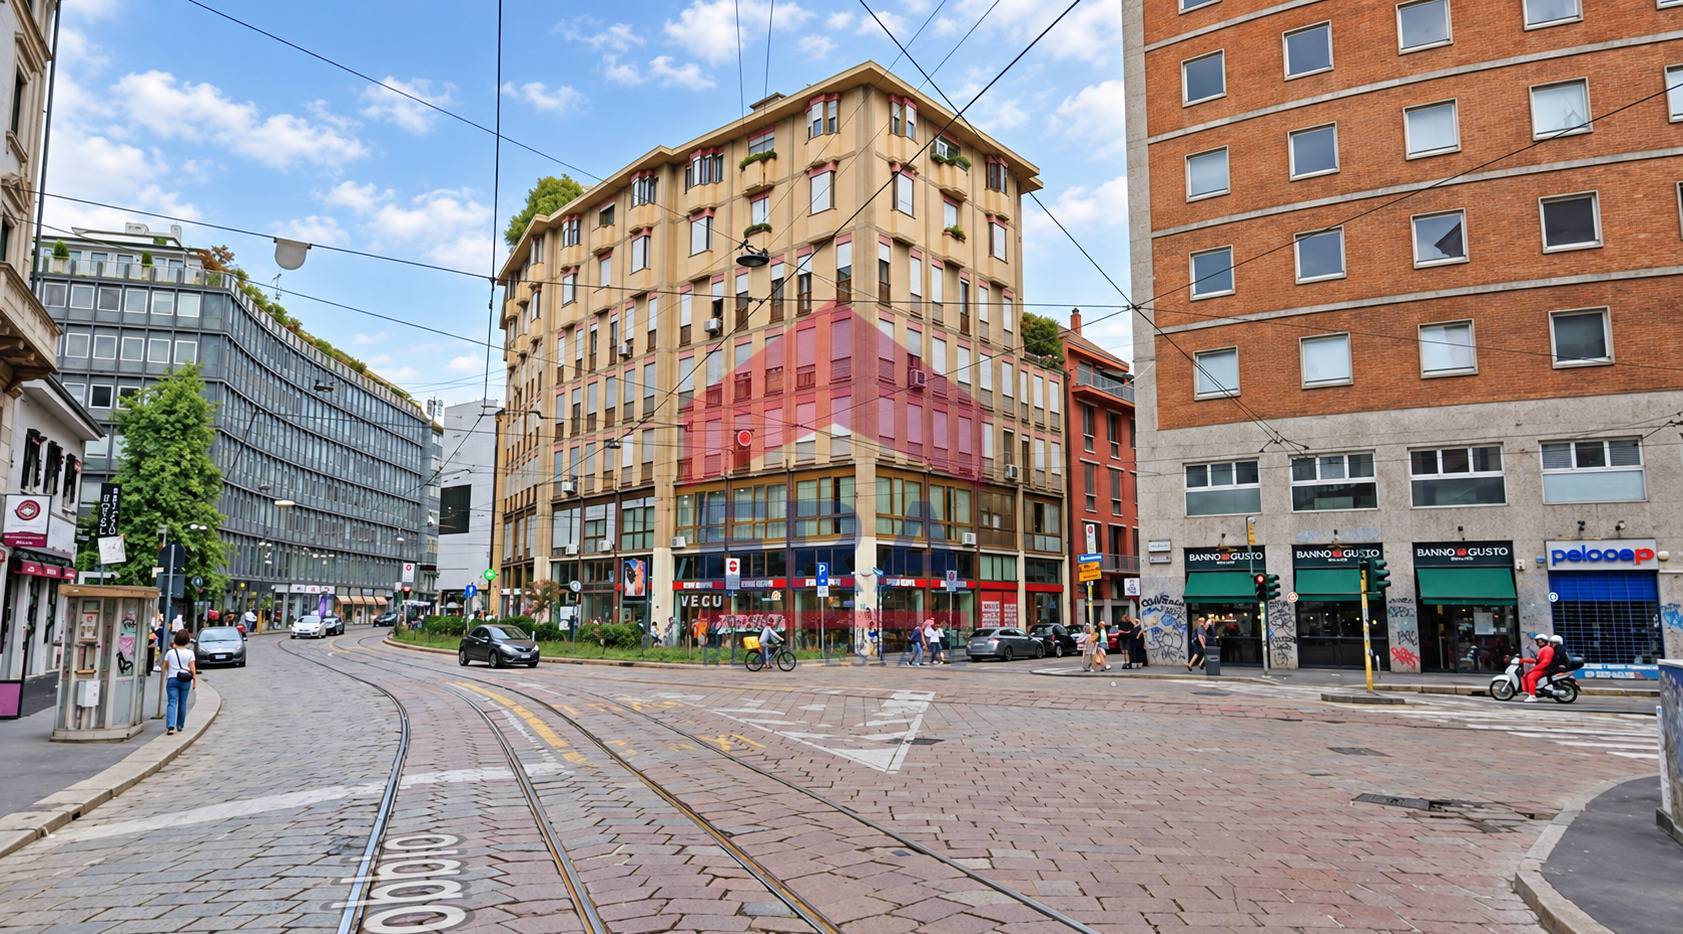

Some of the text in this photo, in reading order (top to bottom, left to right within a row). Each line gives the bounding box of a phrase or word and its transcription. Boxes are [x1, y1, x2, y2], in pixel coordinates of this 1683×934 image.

[1188, 552, 1263, 562] BANNO GUSTO
[1296, 549, 1380, 559] BANNO GUSTO
[1417, 547, 1509, 557] BANNO GUSTO
[818, 564, 826, 576] P
